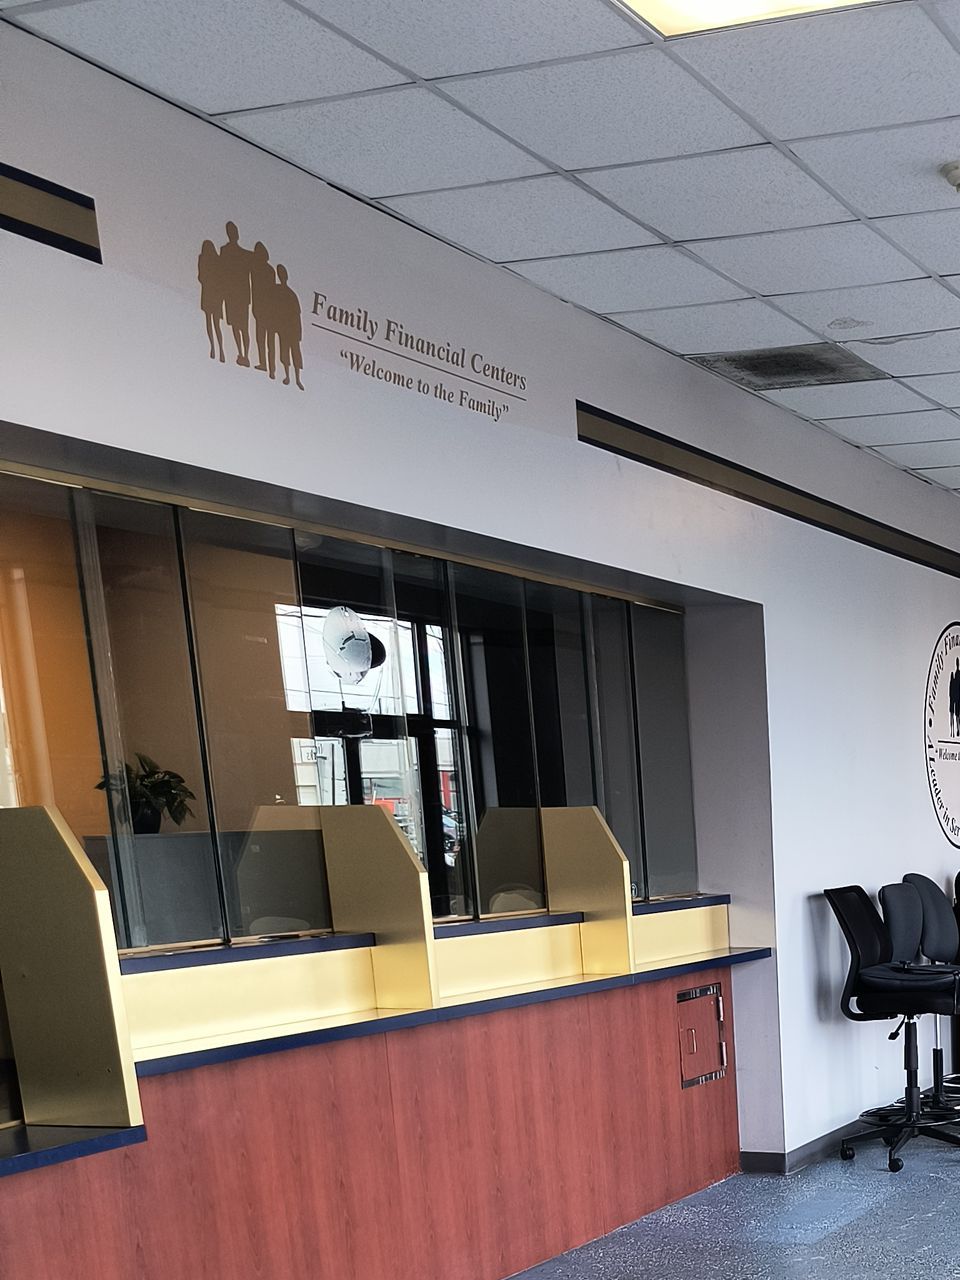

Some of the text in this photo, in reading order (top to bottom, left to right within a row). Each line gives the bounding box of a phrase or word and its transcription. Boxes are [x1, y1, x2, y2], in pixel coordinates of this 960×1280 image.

[311, 291, 527, 390] Family Financial Centers
[340, 349, 509, 422] “Welcome to the Family”
[928, 651, 944, 715] Family
[928, 756, 945, 810] Leader
[942, 807, 950, 826] in
